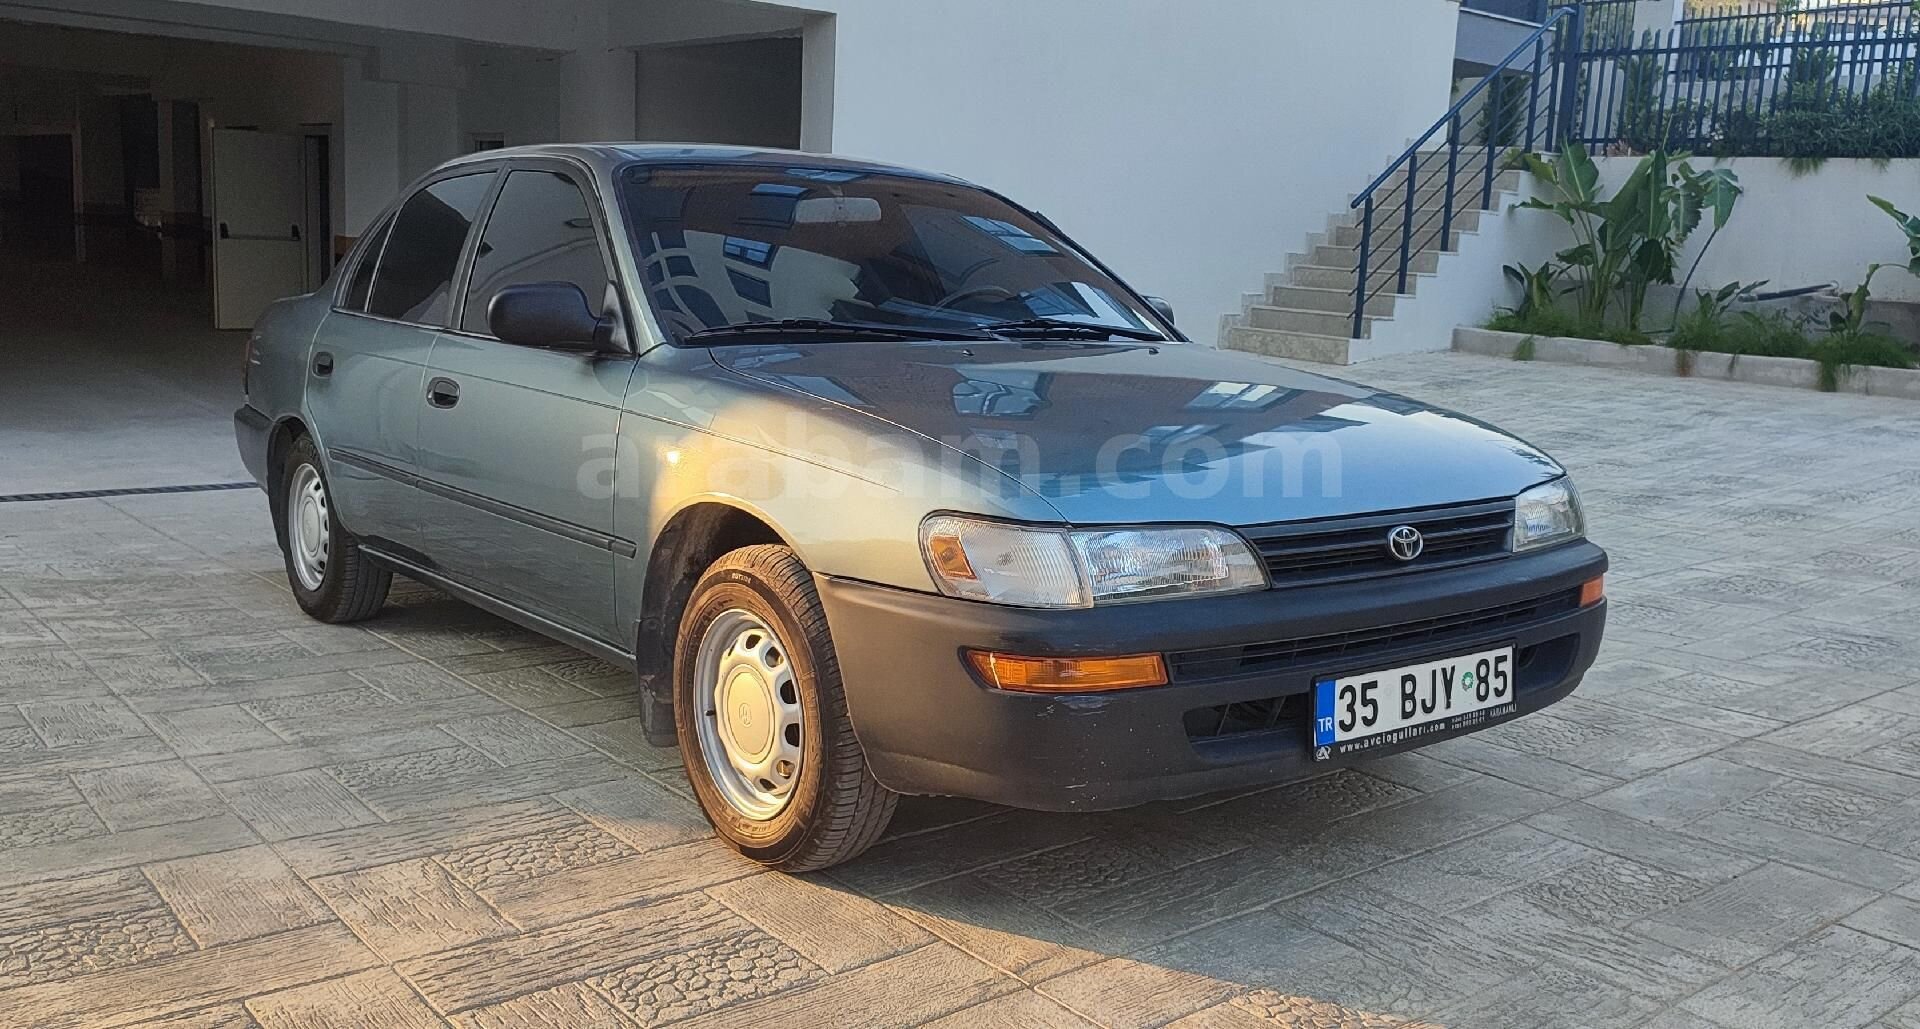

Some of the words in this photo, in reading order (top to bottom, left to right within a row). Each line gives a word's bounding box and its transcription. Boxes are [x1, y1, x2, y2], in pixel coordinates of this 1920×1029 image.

[1338, 680, 1378, 732] 35
[1400, 665, 1456, 719] BJY
[1475, 655, 1508, 702] 85
[1318, 717, 1333, 733] TR
